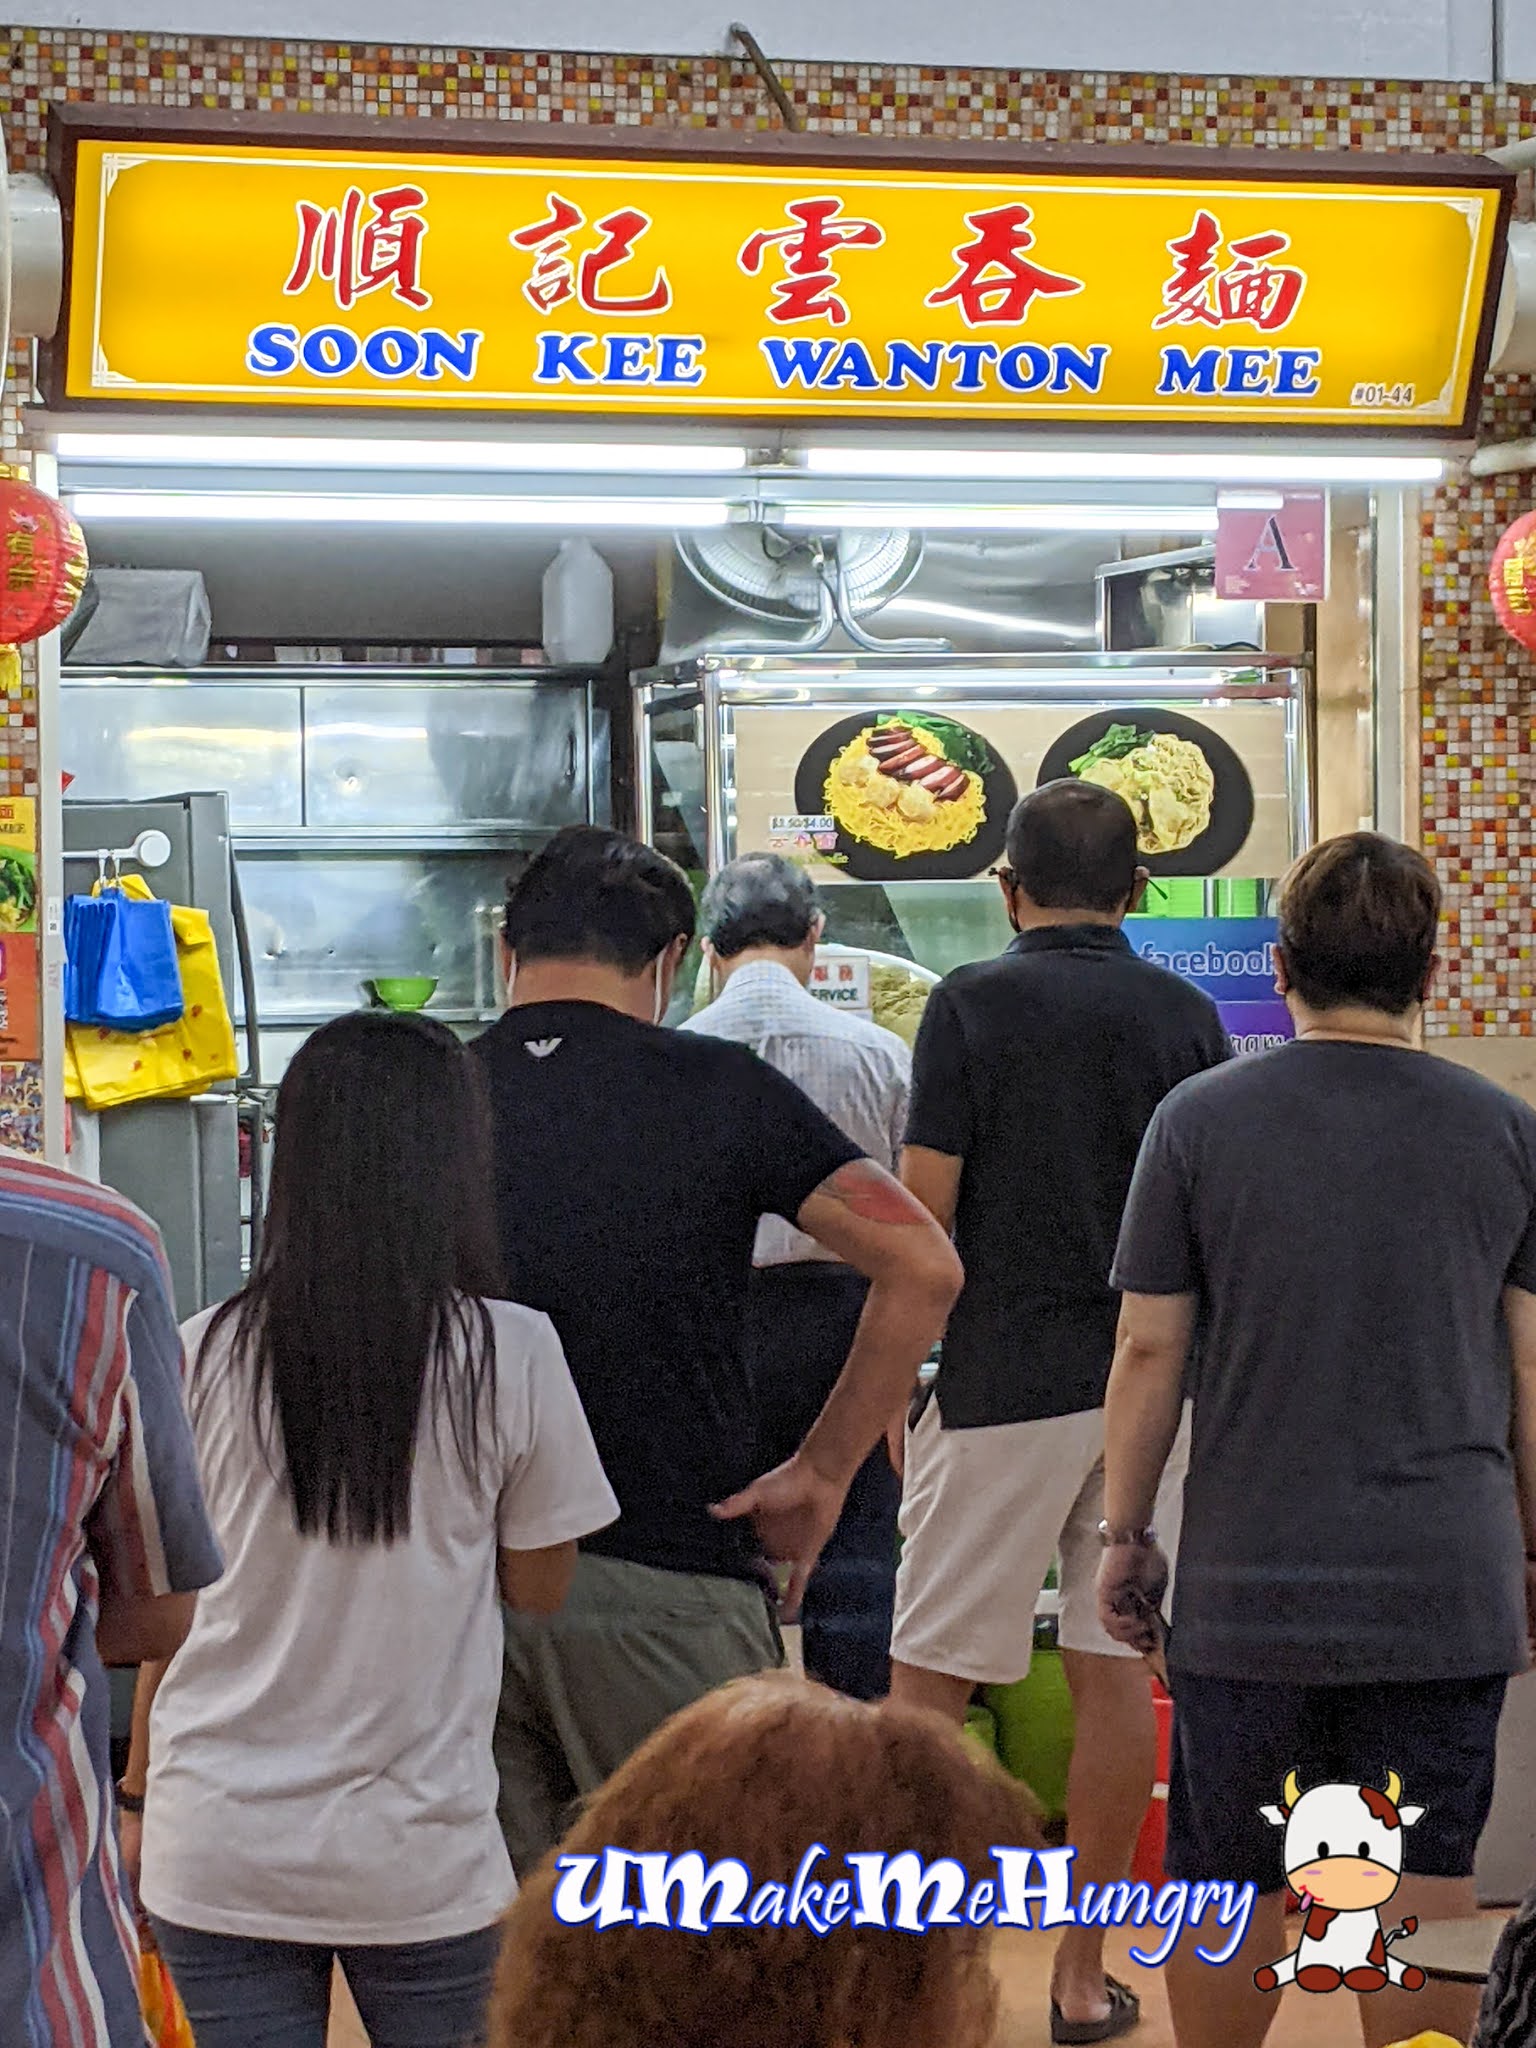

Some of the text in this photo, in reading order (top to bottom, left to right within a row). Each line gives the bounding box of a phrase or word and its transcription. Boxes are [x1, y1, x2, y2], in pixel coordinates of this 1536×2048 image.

[246, 323, 1322, 398] SOON KEE WANTON MEE
[1354, 382, 1414, 405] #01-44
[1242, 514, 1299, 572] A
